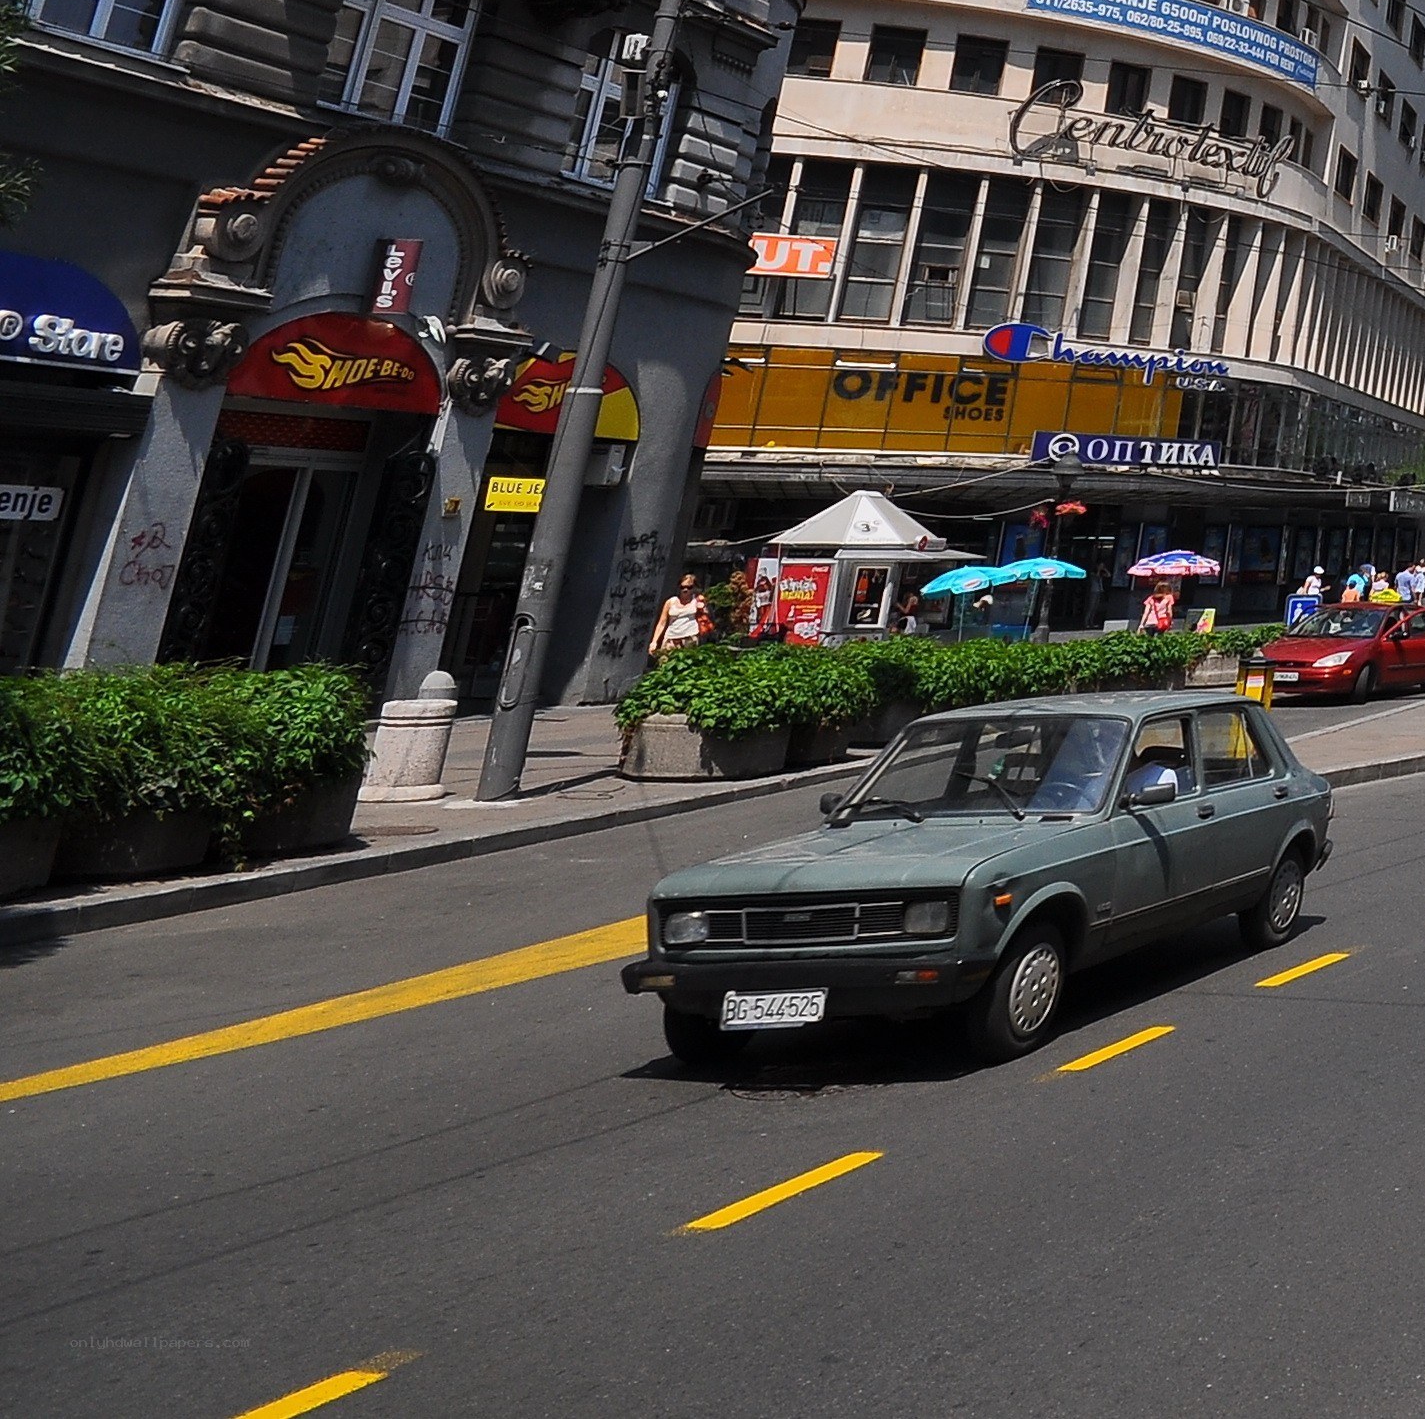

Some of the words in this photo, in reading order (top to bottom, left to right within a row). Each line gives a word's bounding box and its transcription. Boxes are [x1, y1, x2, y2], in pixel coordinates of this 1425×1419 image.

[1213, 16, 1277, 49] POSLOVNOG
[1278, 39, 1317, 69] PROSTORA
[749, 239, 832, 272] UT.
[376, 244, 405, 308] Levi's
[28, 314, 124, 361] Store
[982, 322, 1230, 385] Champion
[832, 367, 1008, 406] OFFICE
[943, 404, 1005, 421] SHOES
[1086, 438, 1217, 467] ОПТИКА
[491, 481, 523, 494] BLUE
